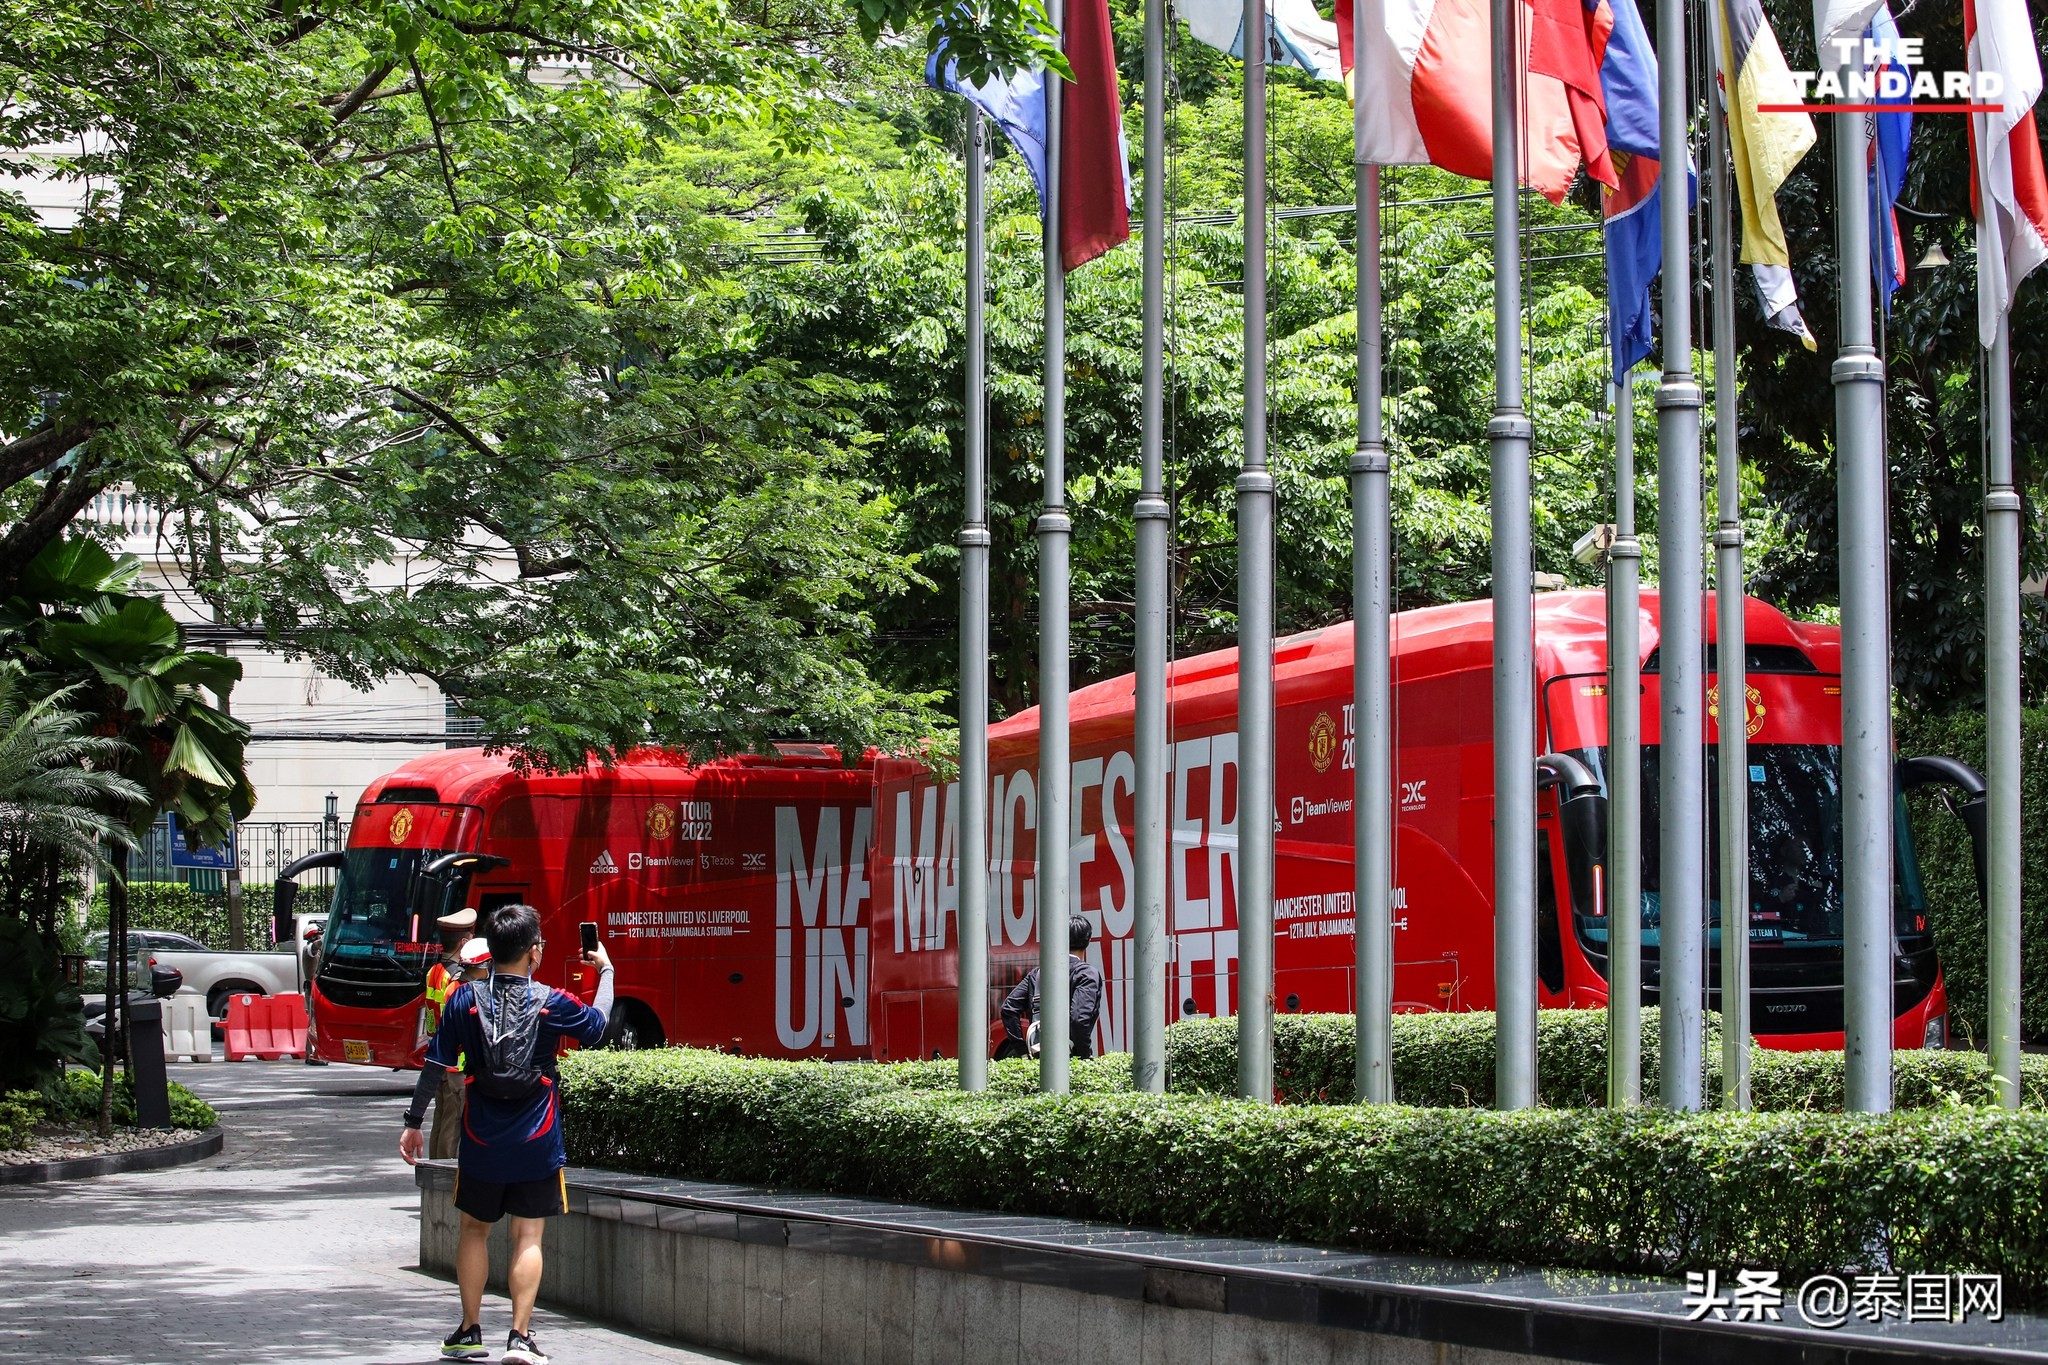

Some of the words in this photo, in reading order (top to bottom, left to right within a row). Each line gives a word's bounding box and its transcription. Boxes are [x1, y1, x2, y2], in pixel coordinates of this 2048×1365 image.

[680, 801, 712, 820] TOUR
[1304, 798, 1353, 817] TeamViewer
[1401, 803, 1427, 812] TECHNOLOGY
[681, 821, 713, 841] 2022
[590, 864, 619, 874] adidas
[644, 855, 694, 867] TeamViewer
[711, 855, 735, 866] Tezos
[1274, 895, 1322, 920] MANCHESTER
[1323, 891, 1351, 915] UNITED
[608, 912, 663, 925] MANCHESTER
[665, 911, 694, 924] UNITED
[695, 911, 706, 923] VS
[708, 910, 750, 923] LIVERPOOL
[628, 928, 644, 938] 12TH
[645, 927, 660, 938] JULY,
[661, 926, 706, 938] RAJAMANGALA
[706, 926, 733, 936] STADIUM
[1289, 923, 1303, 939] 12TH
[1304, 921, 1318, 939] JULY,
[1319, 918, 1355, 937] RAJAMANGAL
[1758, 929, 1773, 937] TEAM
[1766, 1004, 1807, 1013] VOLVO
